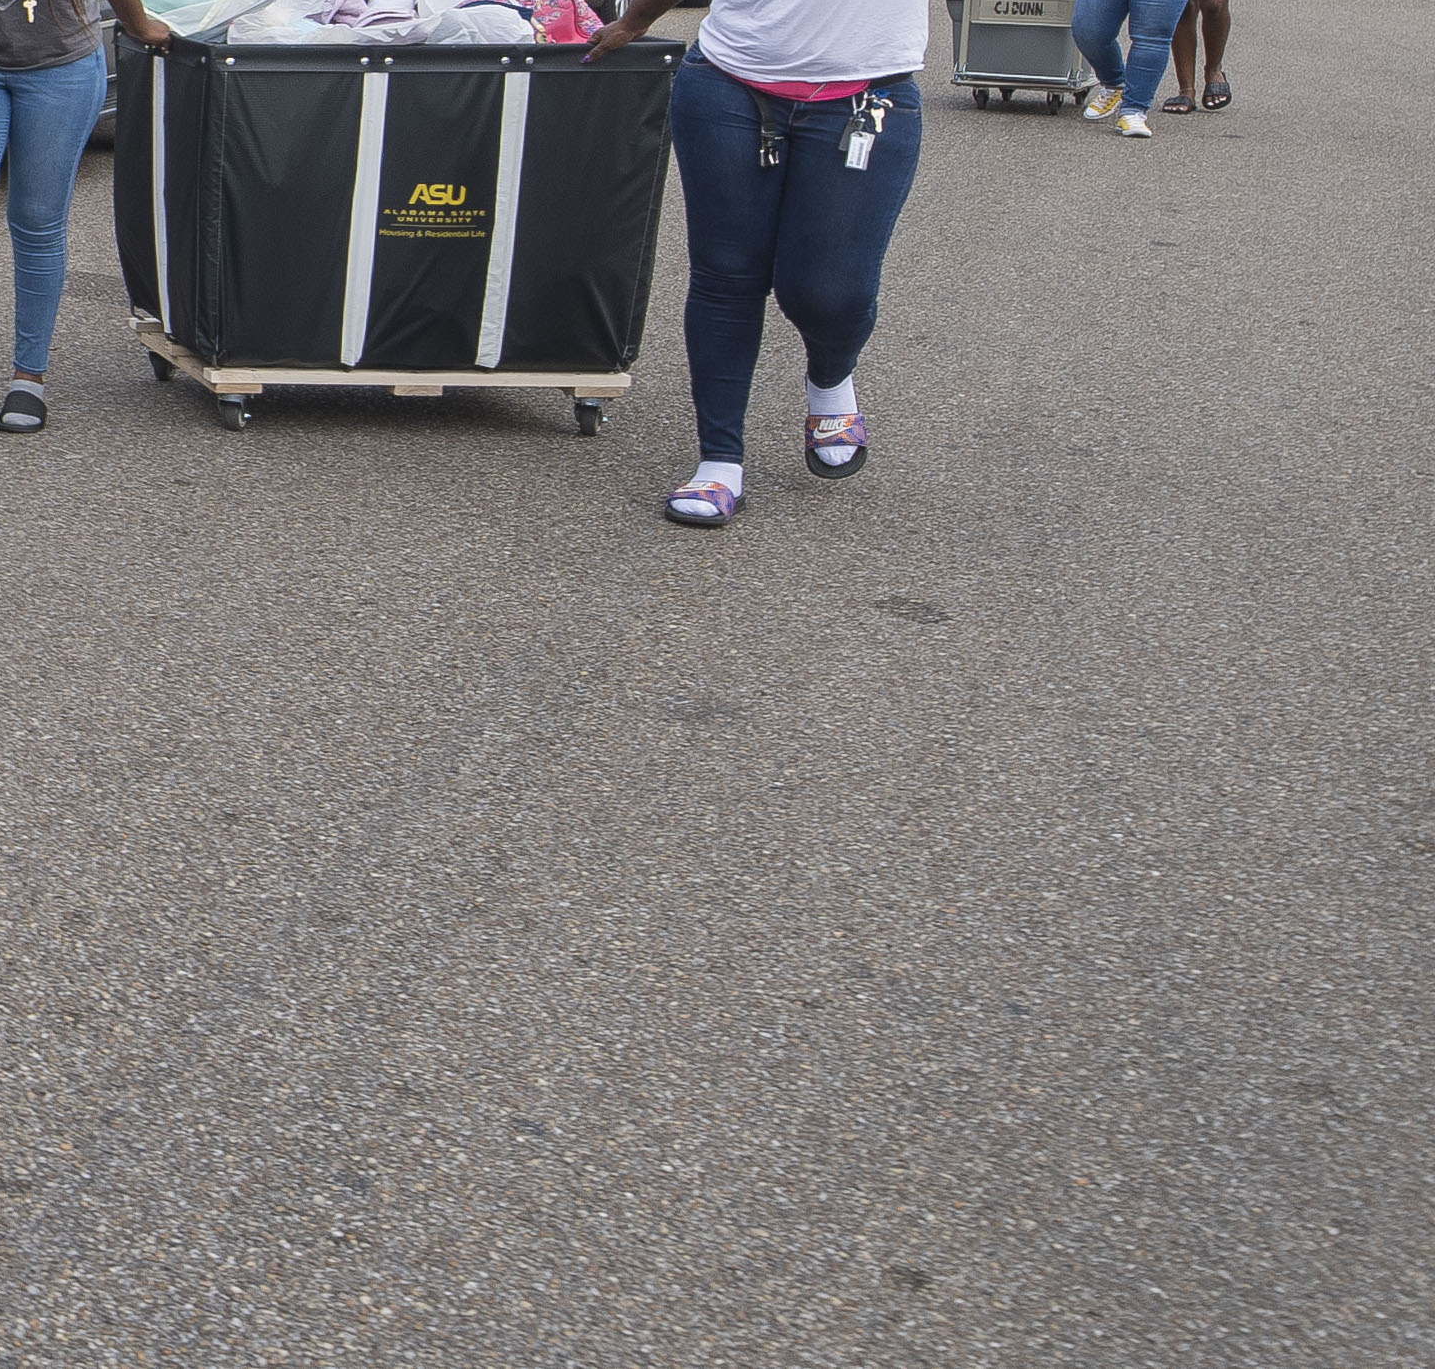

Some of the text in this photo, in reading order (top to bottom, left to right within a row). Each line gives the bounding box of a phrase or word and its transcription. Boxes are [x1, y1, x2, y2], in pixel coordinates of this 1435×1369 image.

[1012, 1, 1044, 16] DUNN
[408, 183, 467, 206] ASU
[383, 208, 486, 217] ALABAMA STATE
[379, 228, 414, 239] Housing
[416, 229, 423, 237] &
[424, 229, 470, 238] Residential
